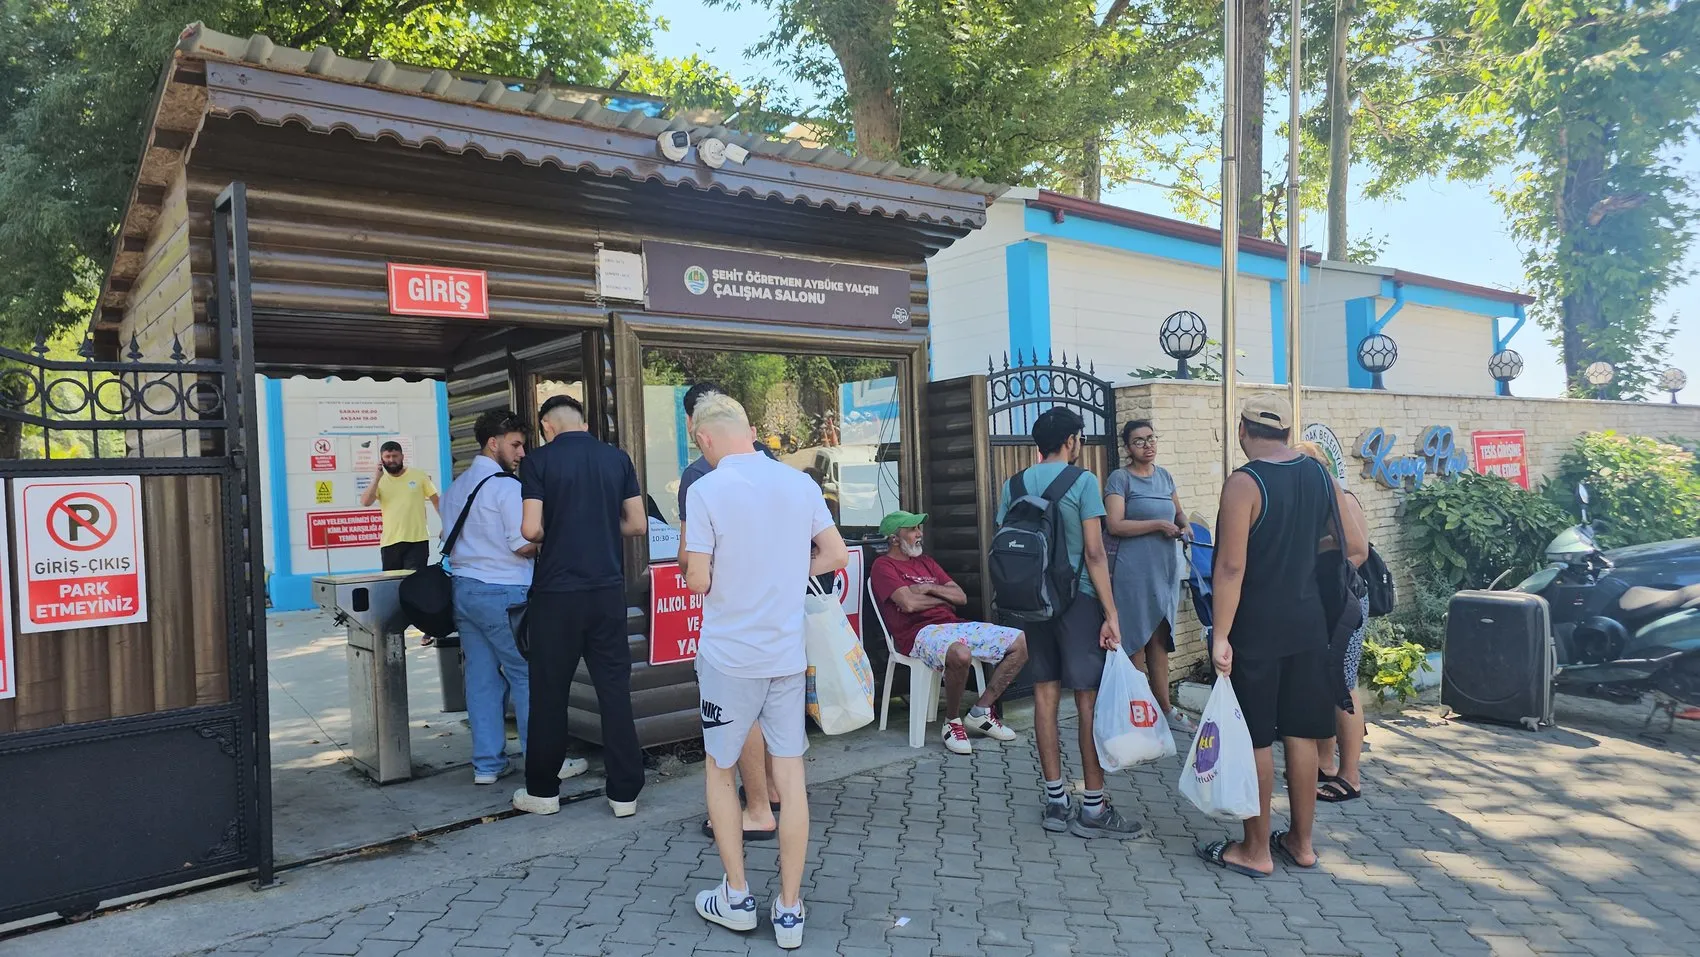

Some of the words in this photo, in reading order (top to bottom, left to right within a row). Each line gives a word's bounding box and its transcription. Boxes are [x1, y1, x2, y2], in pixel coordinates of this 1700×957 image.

[712, 268, 743, 282] ŞEHİT
[746, 271, 802, 288] ÖĞRETMEN
[804, 278, 844, 292] AYBÜKE
[846, 283, 879, 297] YALÇIN
[408, 274, 471, 310] GİRİŞ
[713, 283, 773, 301] ÇALIŞMA
[774, 290, 826, 304] SALONU
[1480, 442, 1498, 460] TESİS
[35, 556, 131, 575] GİRİŞ-ÇIKIŞ
[60, 582, 109, 598] PARK
[675, 574, 687, 589] TE
[36, 595, 133, 619] ETMEYİNİZ
[657, 595, 687, 613] ALKOL
[687, 616, 699, 632] VE
[677, 638, 698, 656] YA
[701, 699, 723, 722] NIKE
